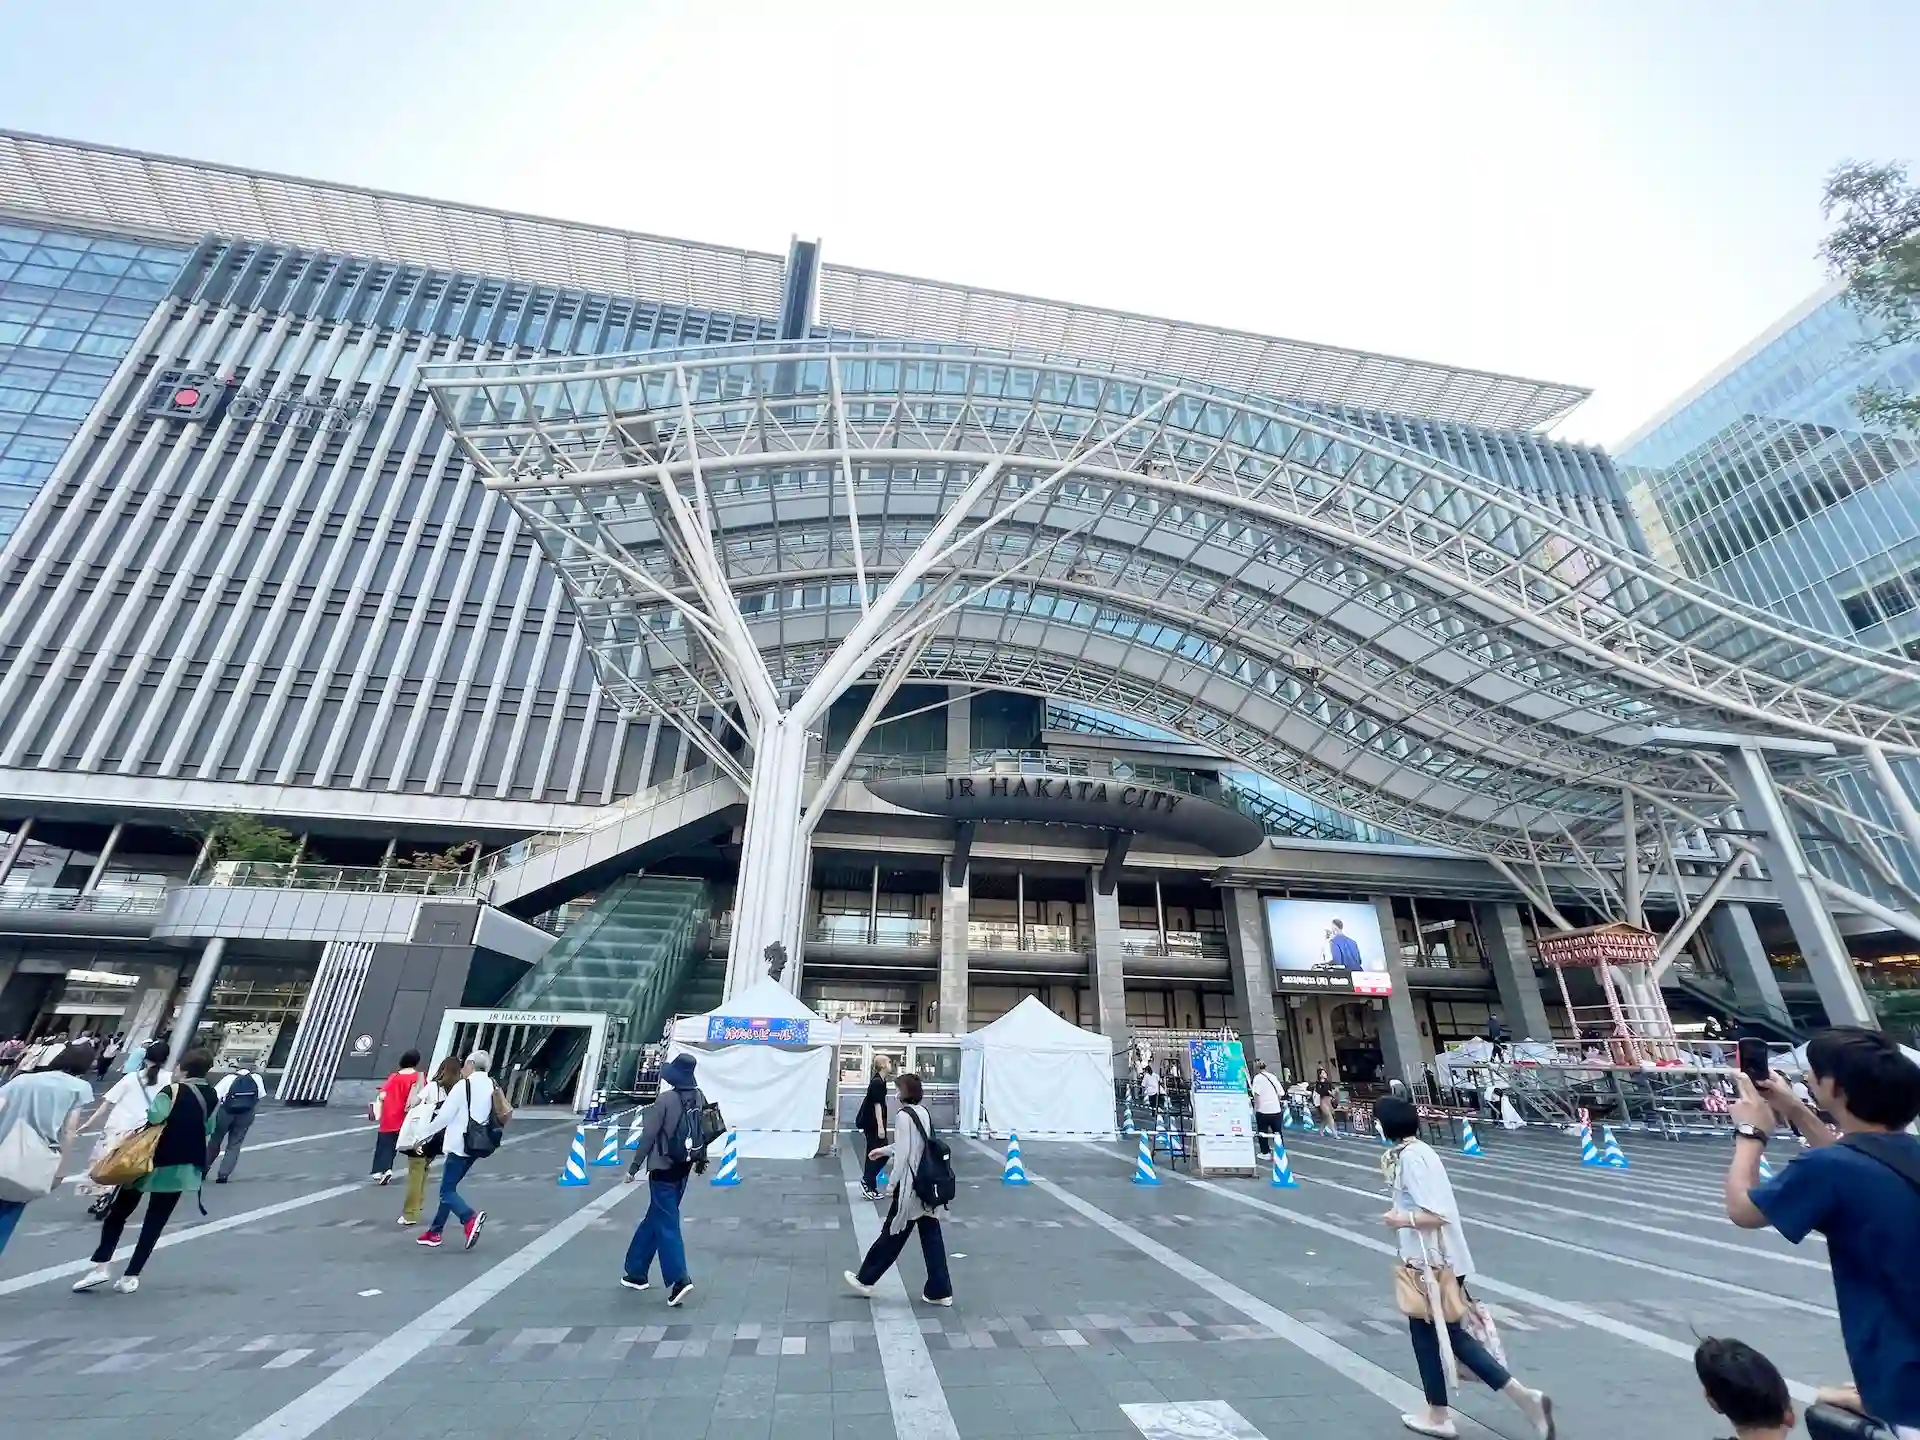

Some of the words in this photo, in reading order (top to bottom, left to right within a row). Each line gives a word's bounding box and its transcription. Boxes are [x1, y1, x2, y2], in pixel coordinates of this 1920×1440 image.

[946, 778, 975, 799] JR
[989, 777, 1108, 802] HAKATA
[1121, 786, 1183, 812] CITY
[488, 1013, 499, 1021] JR
[501, 1013, 537, 1021] HAKATA
[539, 1014, 561, 1022] CITY
